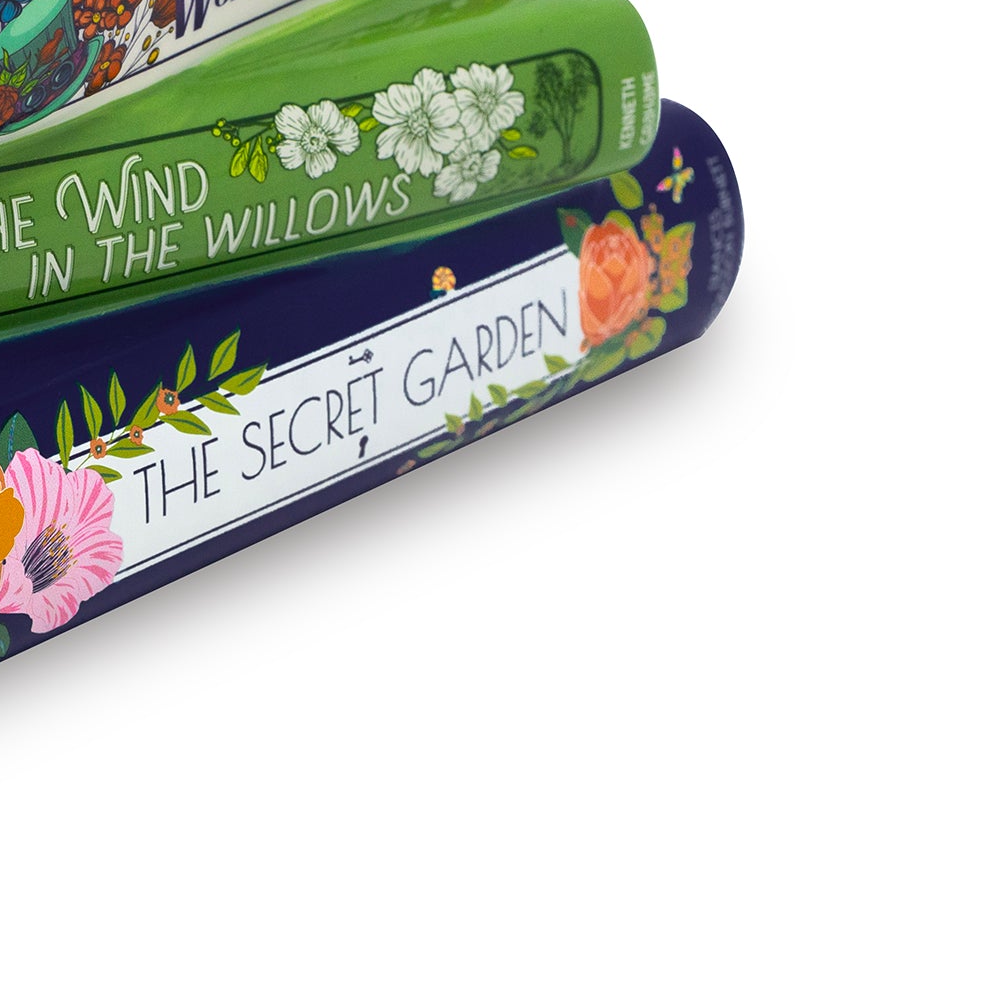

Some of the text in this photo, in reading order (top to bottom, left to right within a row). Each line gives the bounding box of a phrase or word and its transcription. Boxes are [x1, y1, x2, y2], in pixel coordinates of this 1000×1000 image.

[619, 76, 636, 150] KENNETH
[28, 173, 411, 300] IN THE WILLOWS
[56, 154, 210, 234] WIND
[133, 288, 568, 524] THE SECRET GARDEN
